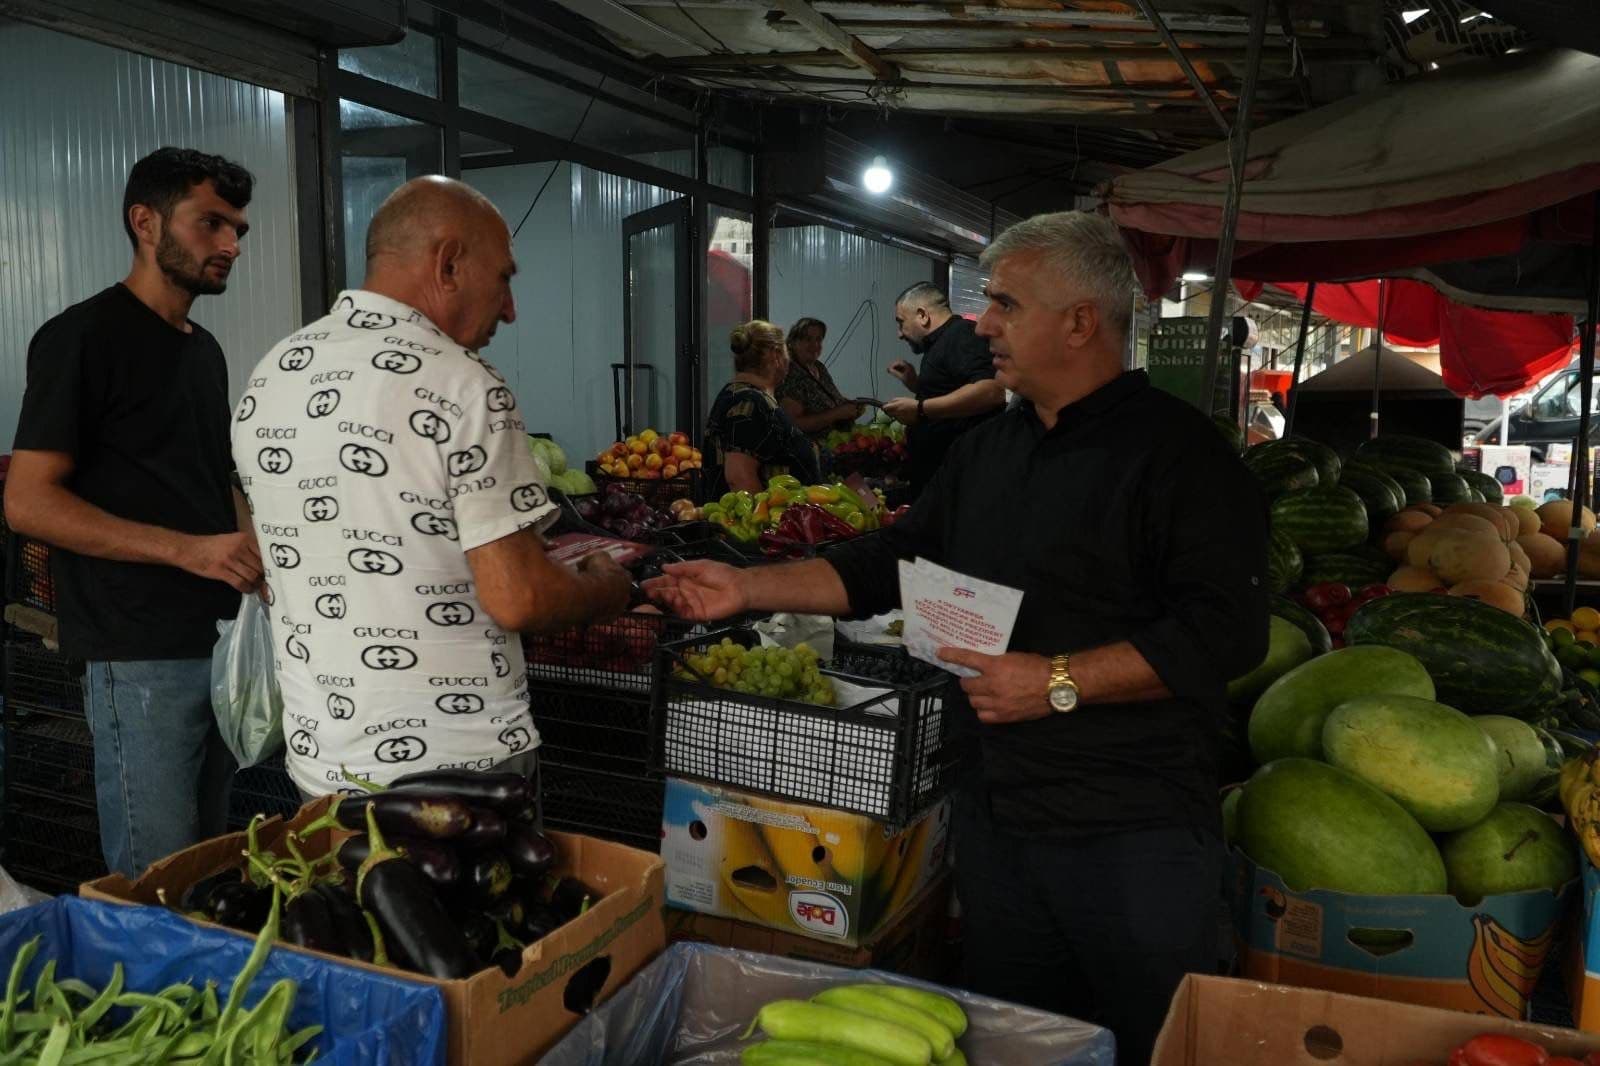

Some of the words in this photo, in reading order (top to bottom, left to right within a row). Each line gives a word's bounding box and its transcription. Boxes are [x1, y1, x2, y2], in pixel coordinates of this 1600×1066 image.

[289, 332, 329, 343] GUCCI
[384, 336, 441, 356] GUCCI
[310, 371, 353, 385] GUCCI
[415, 387, 463, 418] GUCCI
[256, 428, 296, 439] GUCCI
[338, 421, 394, 444] GUCCI
[298, 477, 337, 489] GUCCI
[261, 524, 299, 538] GUCCI
[342, 529, 404, 547] GUCCI
[415, 583, 471, 595] GUCCI
[353, 627, 419, 640] GUCCI
[317, 675, 355, 688] GUCCI
[429, 676, 488, 687] GUCCI
[364, 718, 427, 736] GUCCI
[786, 873, 822, 890] Ecuador
[824, 880, 852, 896] From
[797, 902, 835, 926] Dole
